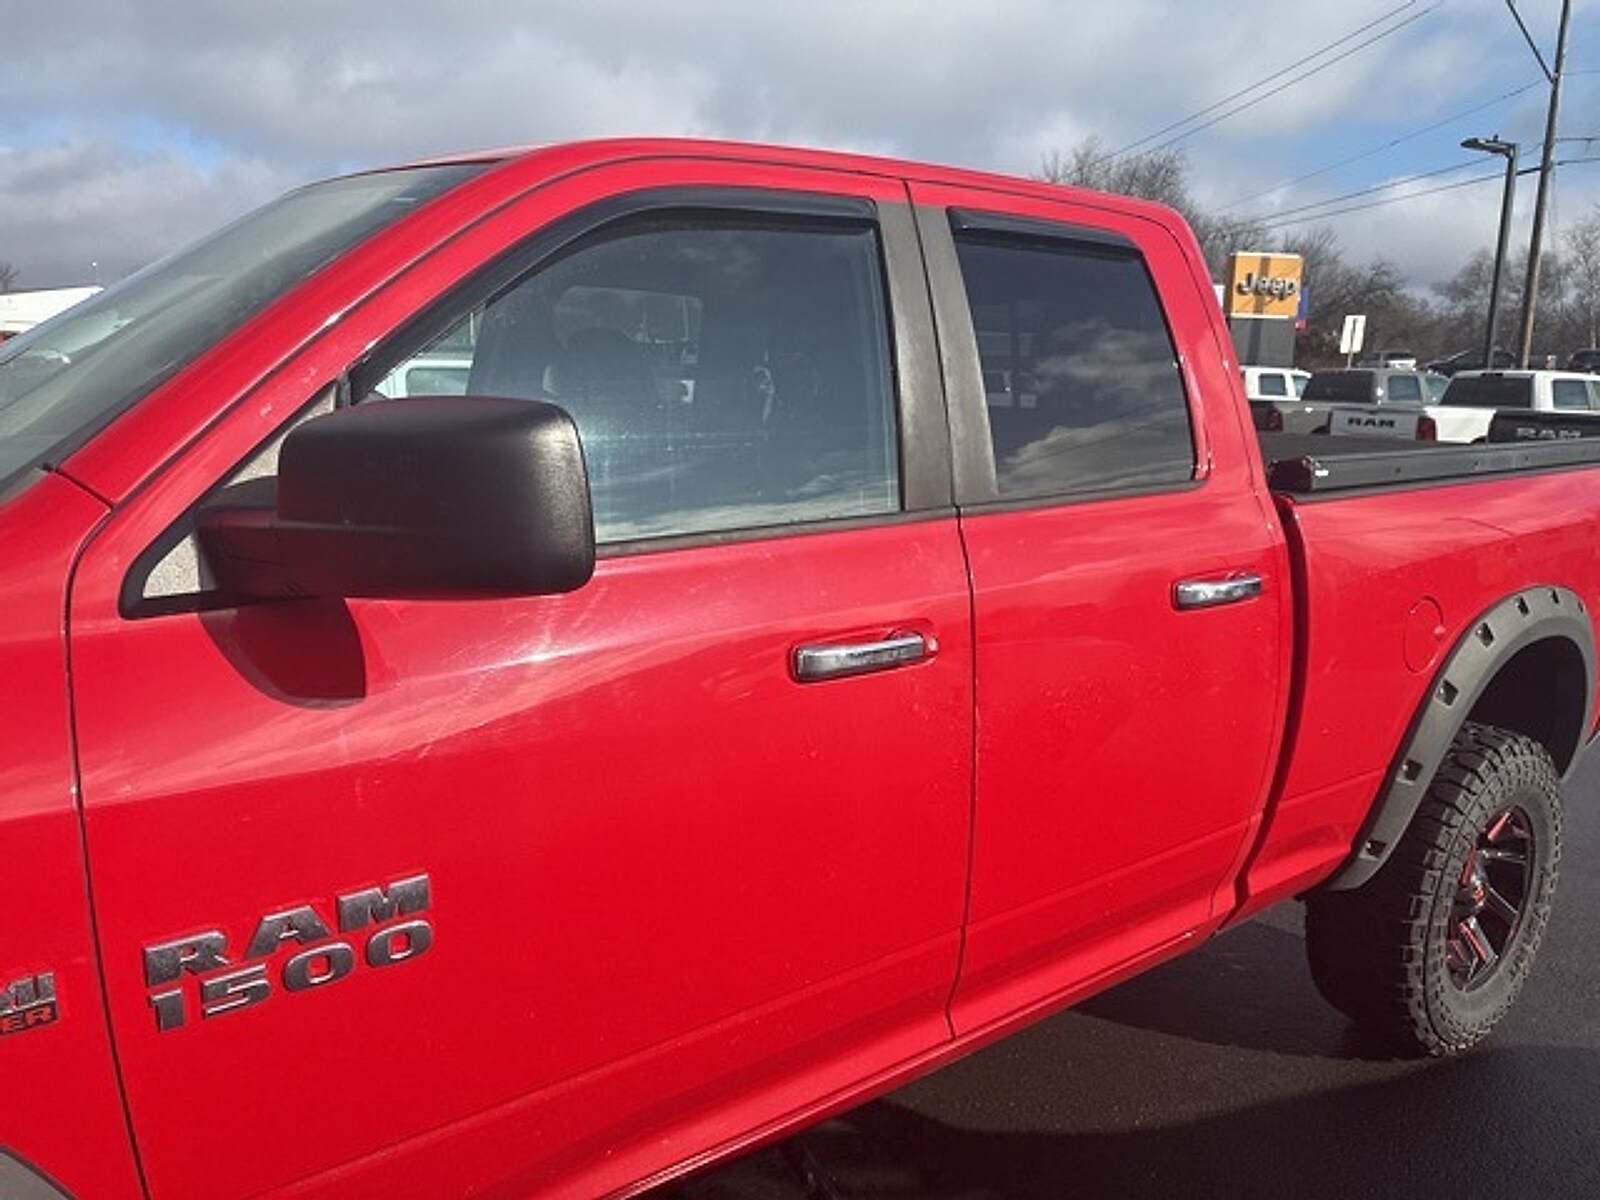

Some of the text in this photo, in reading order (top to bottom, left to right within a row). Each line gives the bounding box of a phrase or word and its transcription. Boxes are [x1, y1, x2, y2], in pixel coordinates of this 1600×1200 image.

[1236, 272, 1297, 301] Jeep
[1348, 417, 1395, 429] RAM
[142, 873, 432, 988] RAM
[149, 919, 435, 1034] 1500
